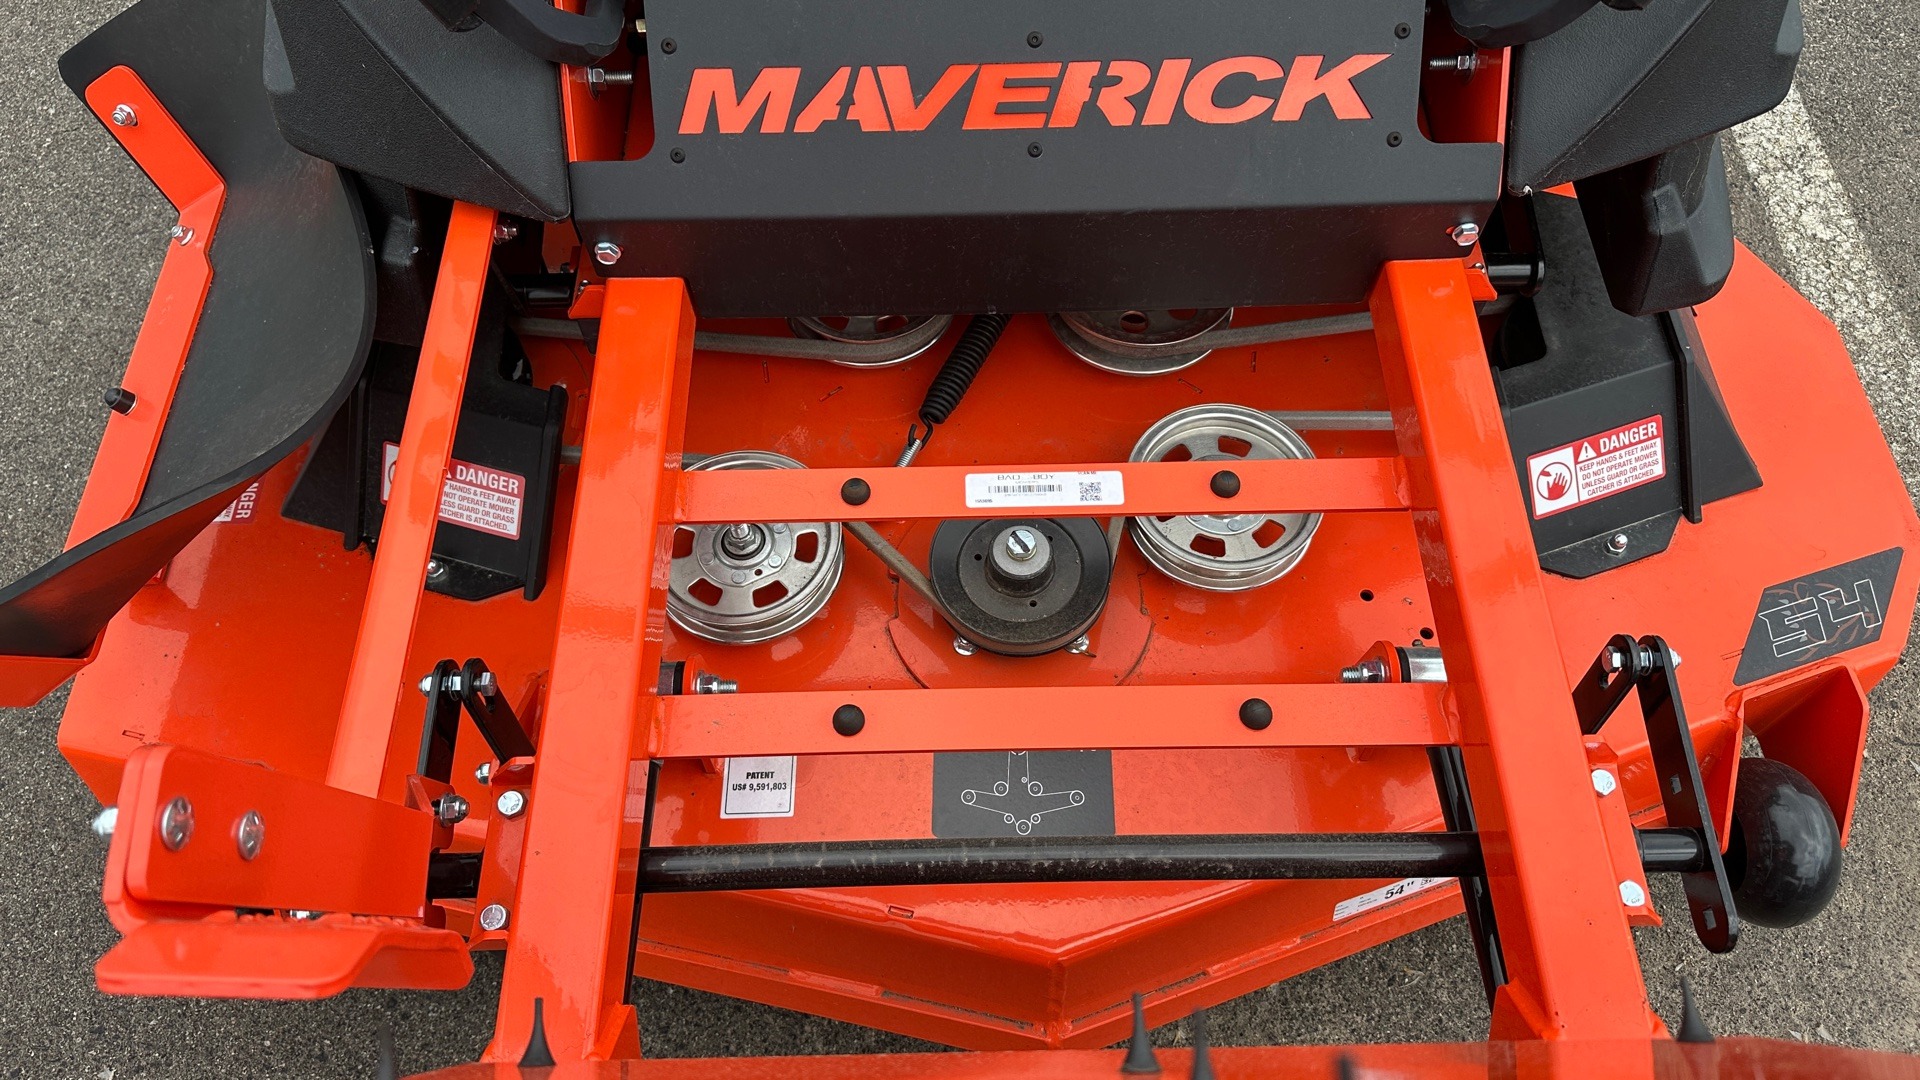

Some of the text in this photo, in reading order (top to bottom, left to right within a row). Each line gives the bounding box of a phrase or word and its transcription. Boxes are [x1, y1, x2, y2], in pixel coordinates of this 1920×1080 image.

[678, 53, 1395, 135] MAVERICK
[1600, 421, 1658, 454] DANGER
[1580, 462, 1594, 472] KEEP
[1596, 455, 1618, 467] HANDS
[1624, 448, 1639, 458] FEET
[1582, 450, 1658, 481] DO NOT OPERATE MOWER
[456, 464, 518, 494] DANGER
[1582, 458, 1660, 490] UNLESS GUARD OR GRASS
[449, 482, 472, 495] HANDS
[473, 489, 478, 497] &
[480, 490, 496, 500] FEET
[1587, 482, 1614, 496] CATCHER
[1616, 479, 1622, 487] IS
[440, 508, 464, 520] ATCHER
[444, 490, 514, 516] NOT OPERATE MOWER
[458, 504, 480, 516] GUARD
[482, 510, 490, 518] OR
[492, 512, 515, 524] GRASS
[1758, 578, 1882, 658] 54
[732, 782, 787, 792] US# 9,591,803
[746, 772, 775, 780] PATENT
